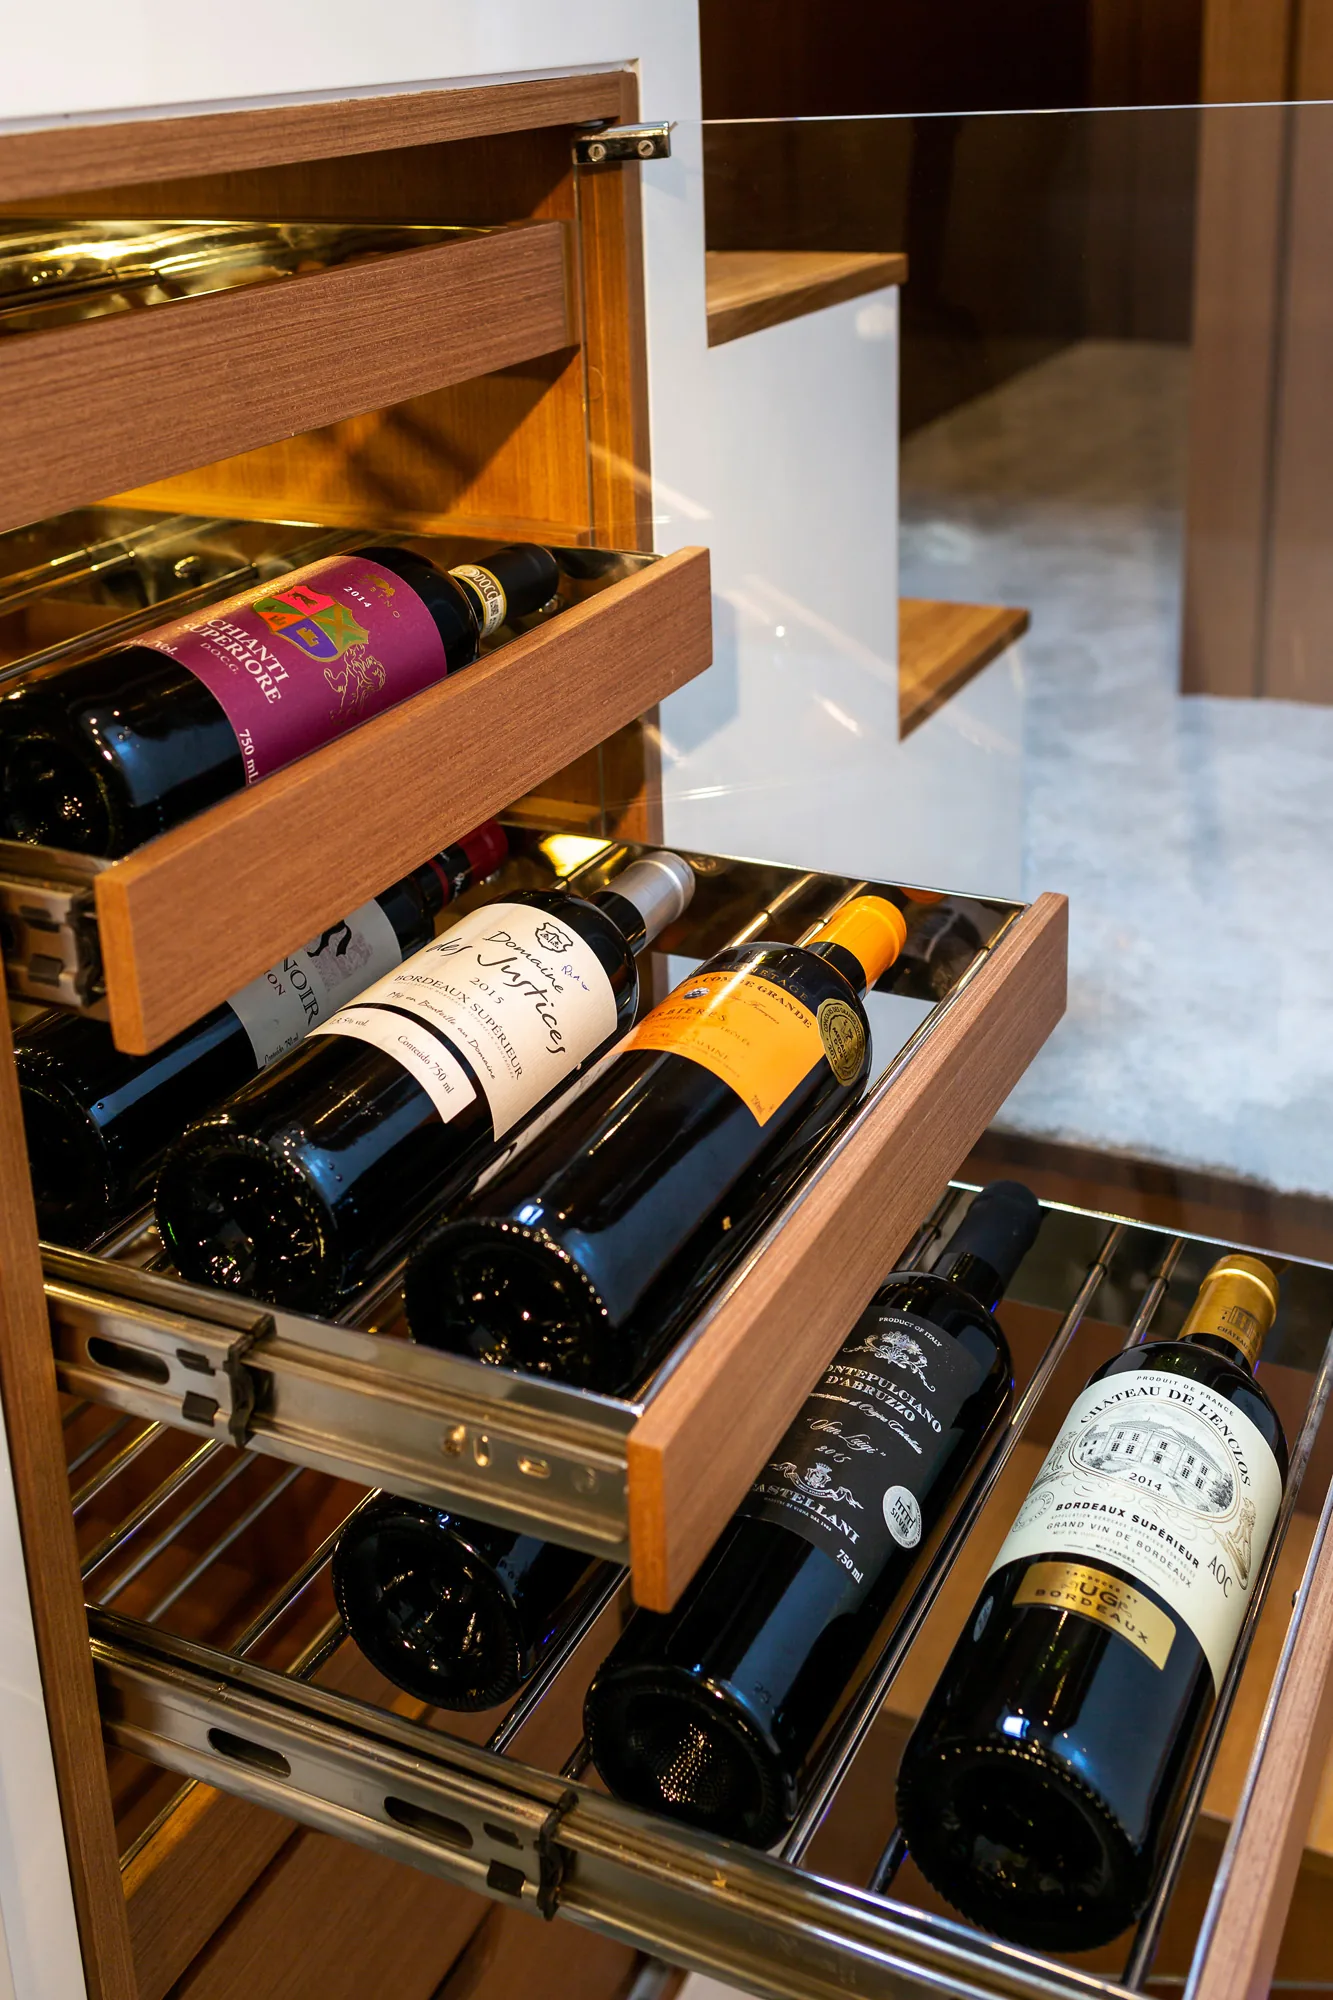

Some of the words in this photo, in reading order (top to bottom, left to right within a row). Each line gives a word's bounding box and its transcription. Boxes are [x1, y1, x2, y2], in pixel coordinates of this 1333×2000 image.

[343, 586, 372, 608] 2014
[473, 574, 499, 601] DOCG
[179, 622, 282, 704] SUPERIORE
[200, 642, 241, 675] D.O.C.G.
[206, 618, 290, 684] CHIANTI
[239, 728, 255, 756] 750
[483, 930, 564, 994] Domaine
[425, 937, 473, 957] des
[477, 953, 567, 1056] Justices
[469, 976, 505, 1005] 2015
[757, 984, 813, 1029] GRANDE
[394, 975, 470, 1004] BORDEAUX
[469, 1002, 524, 1081] SUPÉRIEUR
[397, 1034, 431, 1066] Conteúdo
[429, 1061, 447, 1083] 750
[442, 1080, 455, 1095] ml
[467, 1038, 496, 1081] Domaine
[879, 1316, 915, 1328] PRODUCT
[914, 1325, 925, 1333] OF
[924, 1331, 943, 1347] ITALY
[825, 1364, 942, 1433] ONTEPULCIANO
[825, 1375, 916, 1422] D'ABRUZZO
[1136, 1375, 1179, 1386] PRODUIT
[1183, 1383, 1196, 1393] DE
[1199, 1391, 1235, 1417] FRANCE
[814, 1445, 852, 1463] 2015
[1080, 1386, 1161, 1424] CHÂTEAU
[1168, 1388, 1195, 1406] DE
[1198, 1403, 1252, 1487] L'ENCLOS
[1128, 1472, 1163, 1492] 2014
[890, 1508, 910, 1537] SILVER
[1055, 1501, 1126, 1518] BORDEAUX
[1131, 1514, 1200, 1568] SUPÉRIEUR
[836, 1549, 854, 1570] 750
[851, 1567, 864, 1584] ml
[1046, 1520, 1085, 1531] GRAND
[1089, 1523, 1111, 1534] VIN
[1115, 1530, 1131, 1543] DE
[1136, 1540, 1193, 1588] BORDEAUX
[1207, 1554, 1233, 1599] AOC
[1034, 1588, 1150, 1645] BORDEAUX
